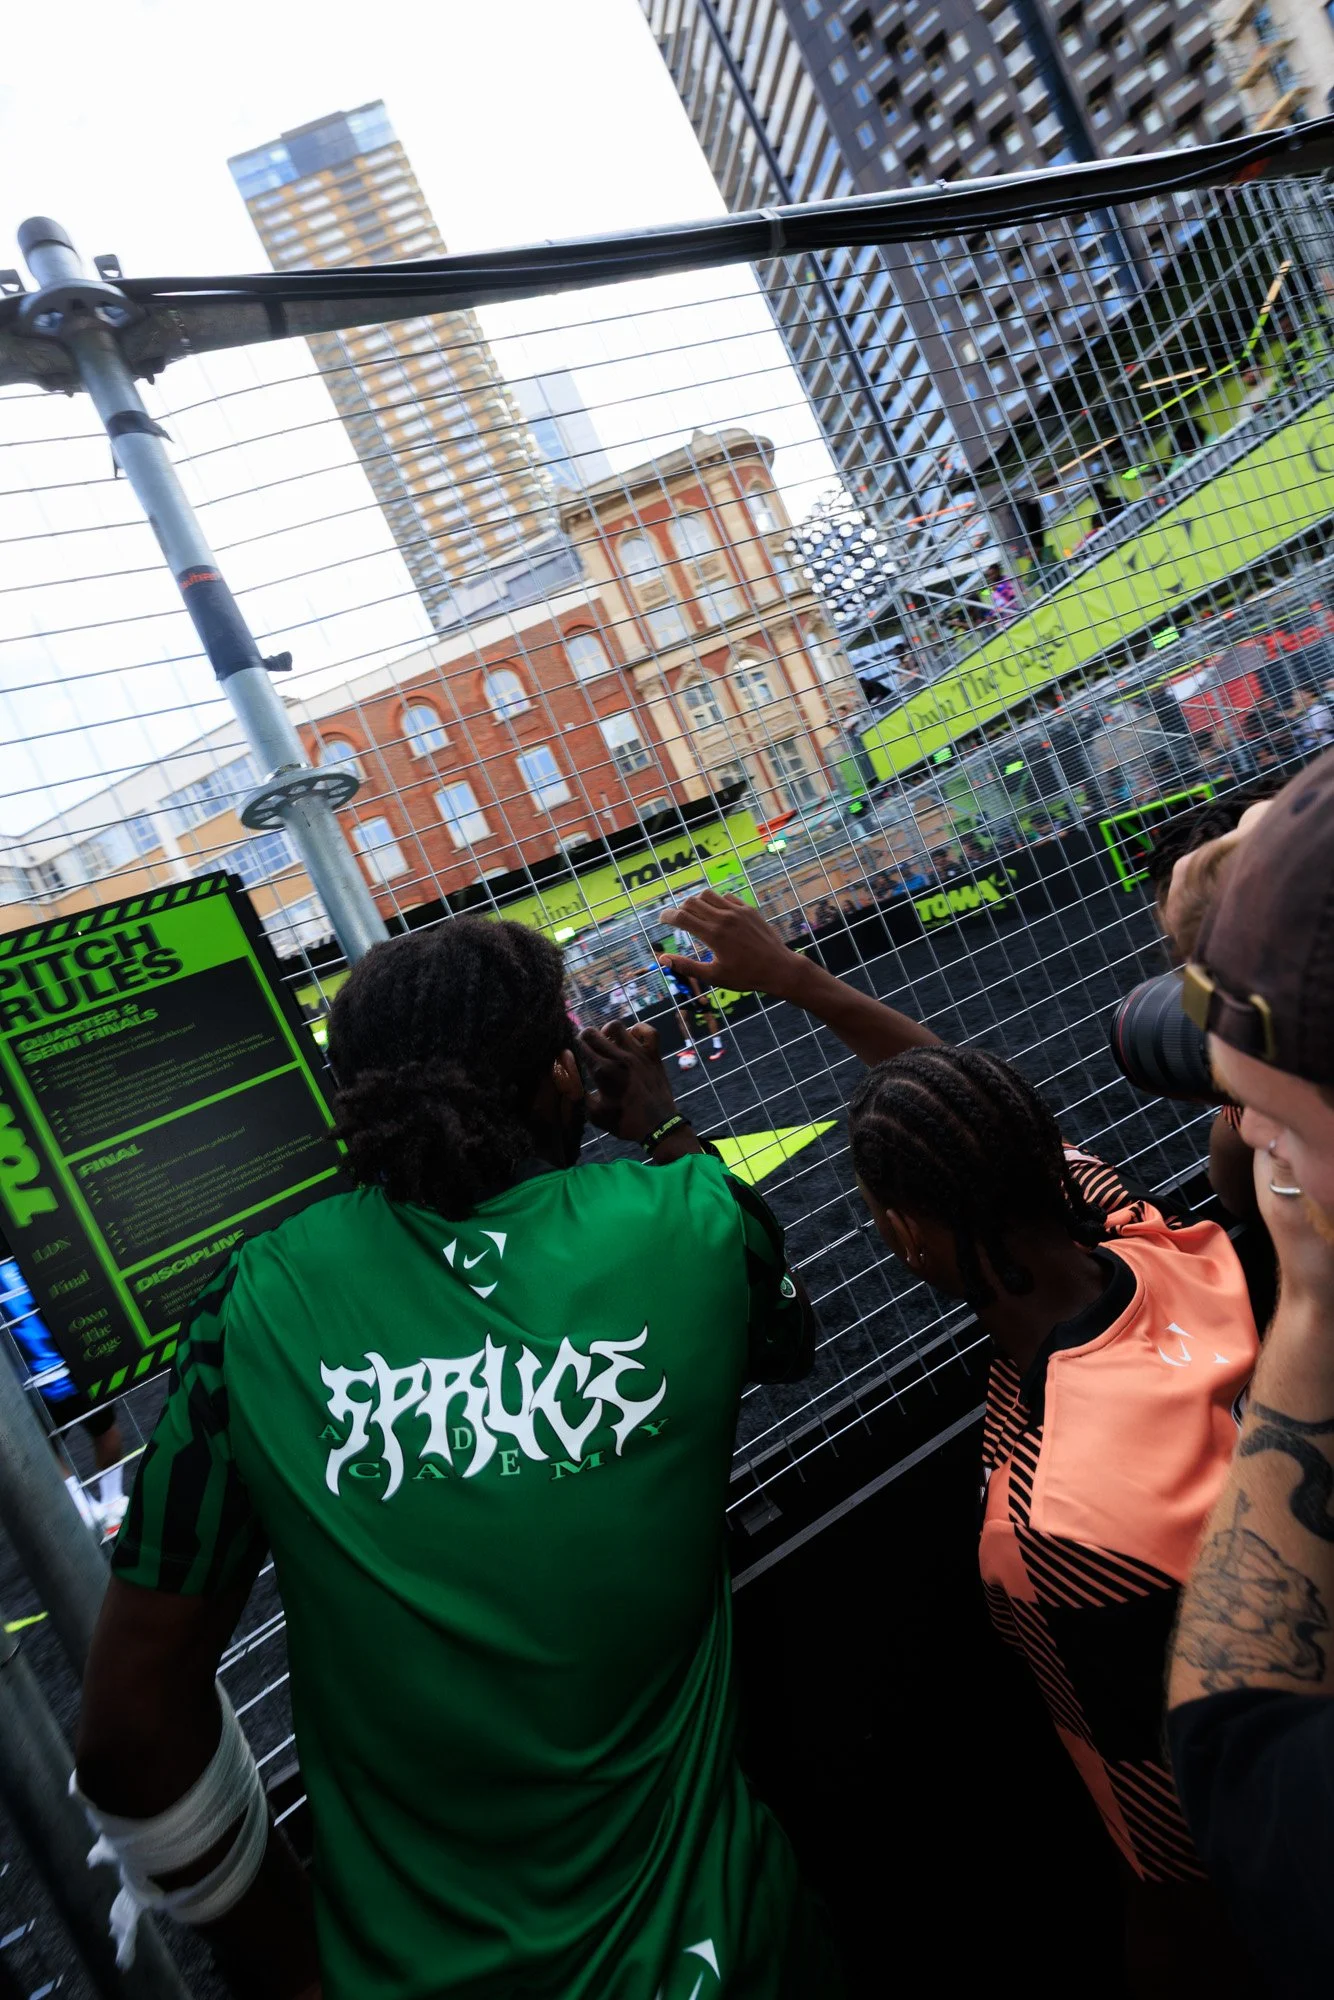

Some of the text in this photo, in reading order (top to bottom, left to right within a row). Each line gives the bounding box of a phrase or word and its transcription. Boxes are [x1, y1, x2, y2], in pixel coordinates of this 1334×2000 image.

[951, 670, 998, 709] The
[0, 923, 161, 990] PITCH
[0, 947, 184, 1032] RULES
[17, 1008, 120, 1052] QUARTER
[22, 1008, 159, 1066] SEMI FINALS
[79, 1144, 144, 1178] FINAL
[50, 1269, 90, 1299] Final
[69, 1308, 108, 1332] Own
[80, 1324, 112, 1347] The
[83, 1336, 122, 1362] Cage
[320, 1320, 667, 1502] SPRUCE
